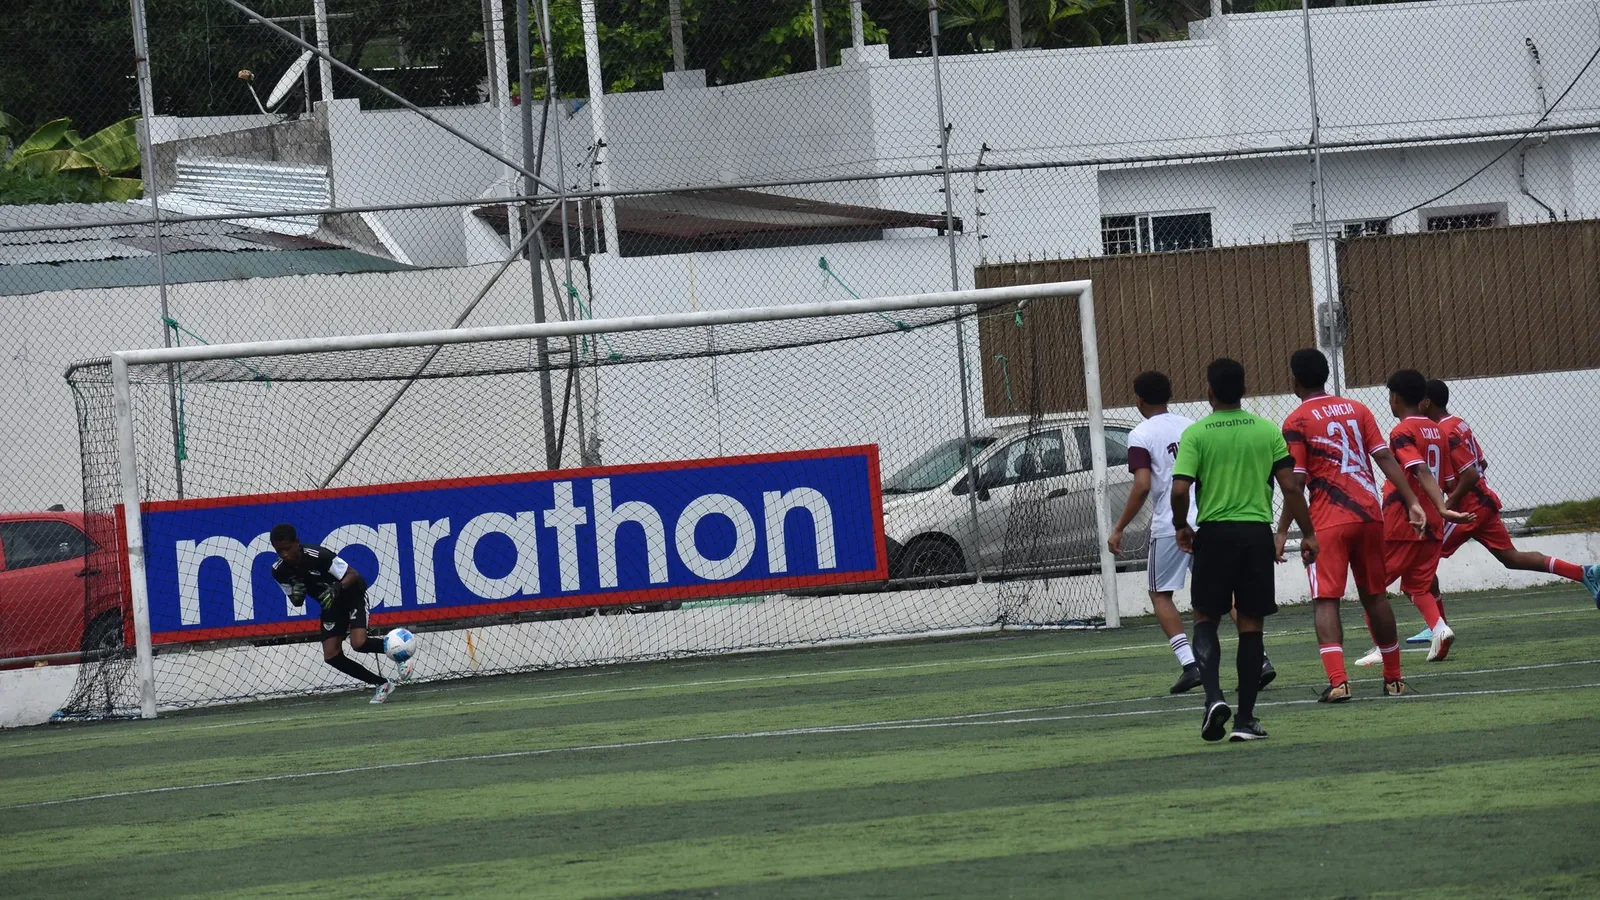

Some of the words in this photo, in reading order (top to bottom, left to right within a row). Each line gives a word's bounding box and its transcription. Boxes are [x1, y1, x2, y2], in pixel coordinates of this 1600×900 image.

[1204, 418, 1256, 429] marathon
[1321, 403, 1355, 418] GARCIA
[1327, 419, 1370, 474] 21
[1427, 444, 1440, 485] 9
[175, 477, 837, 626] marathon
